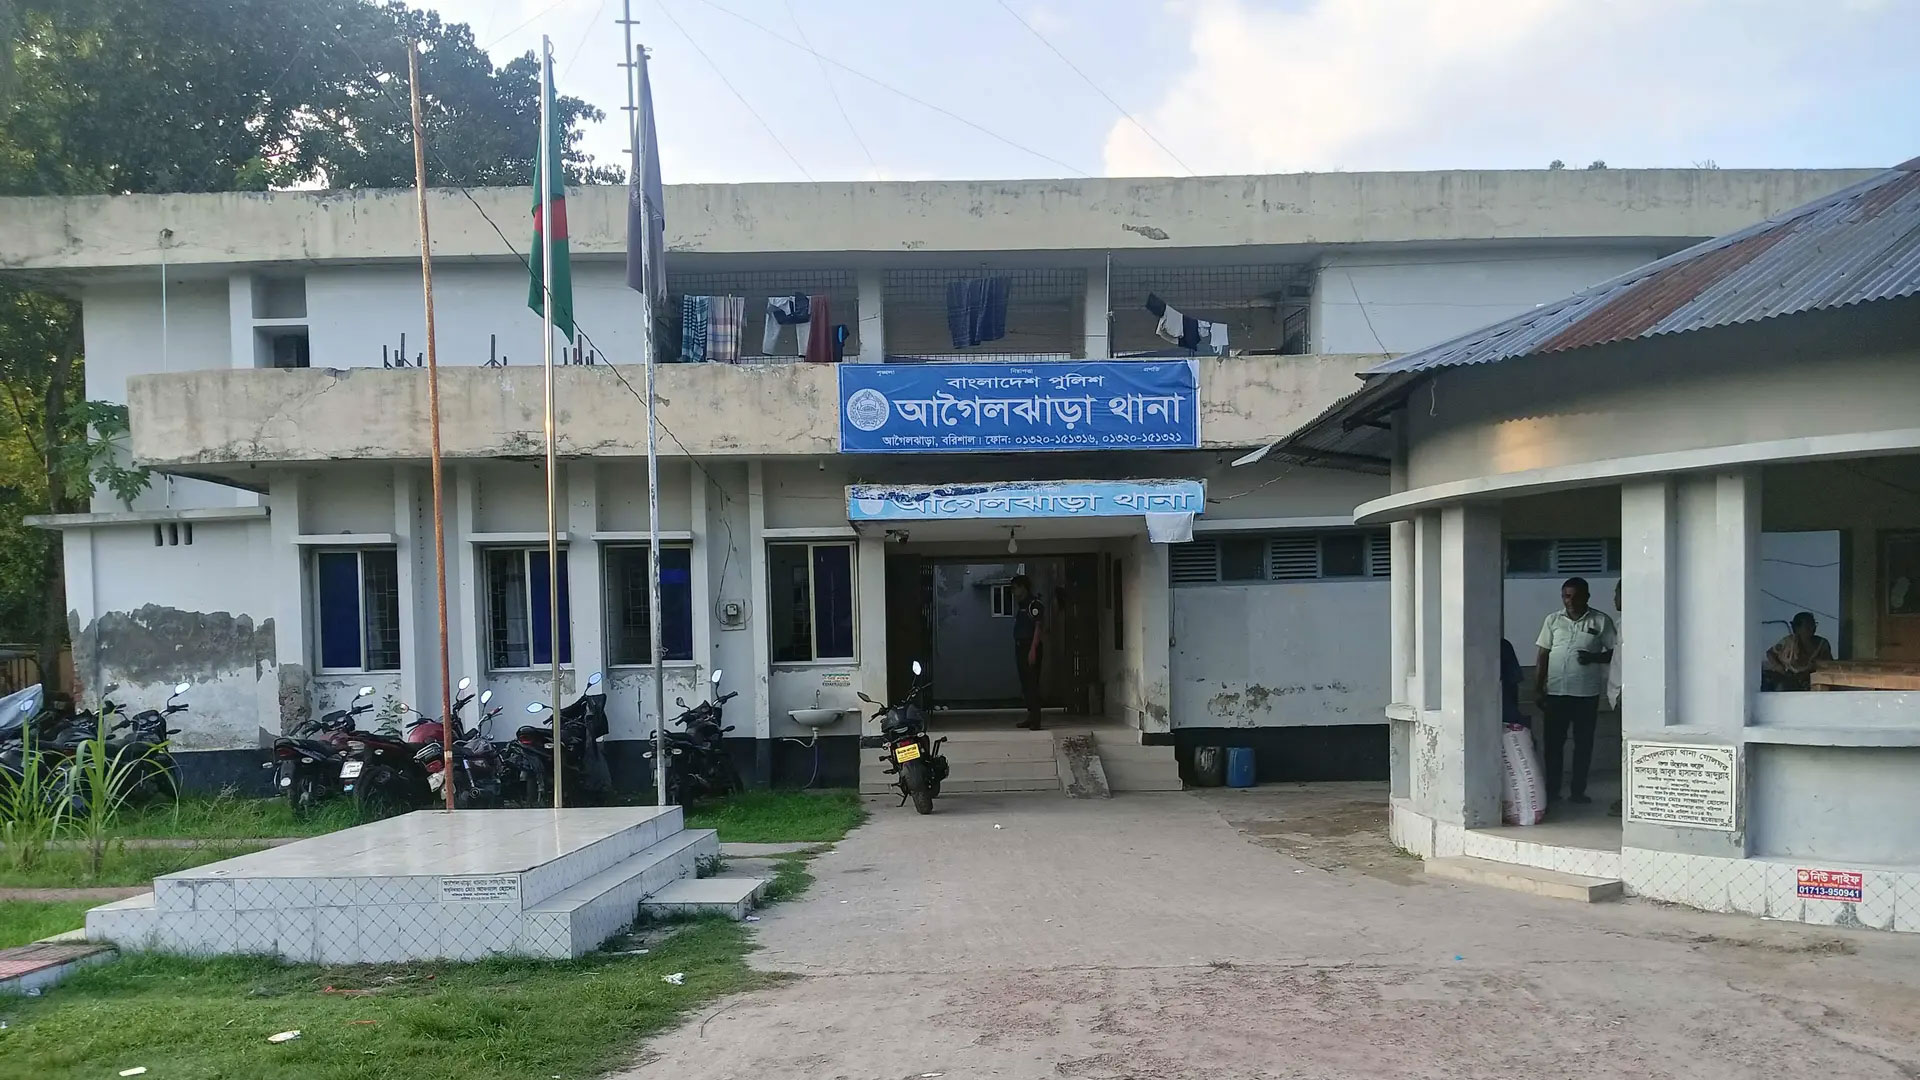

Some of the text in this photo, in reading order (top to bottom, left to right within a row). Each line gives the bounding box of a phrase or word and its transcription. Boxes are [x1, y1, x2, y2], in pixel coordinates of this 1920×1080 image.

[944, 373, 1105, 391] বাংলাদেশ পুলিশ
[891, 390, 1186, 430] আগৈলঝাড়া থানা
[882, 434, 938, 447] আগৈলঝাড়া,
[1102, 432, 1182, 444] ০১৩২০-১৫১৩২১
[1113, 491, 1195, 510] থানা
[1680, 749, 1697, 758] থানা
[1810, 869, 1830, 883] নিউ
[1831, 872, 1860, 885] লাইফ
[1799, 886, 1860, 898] 01713-950941
